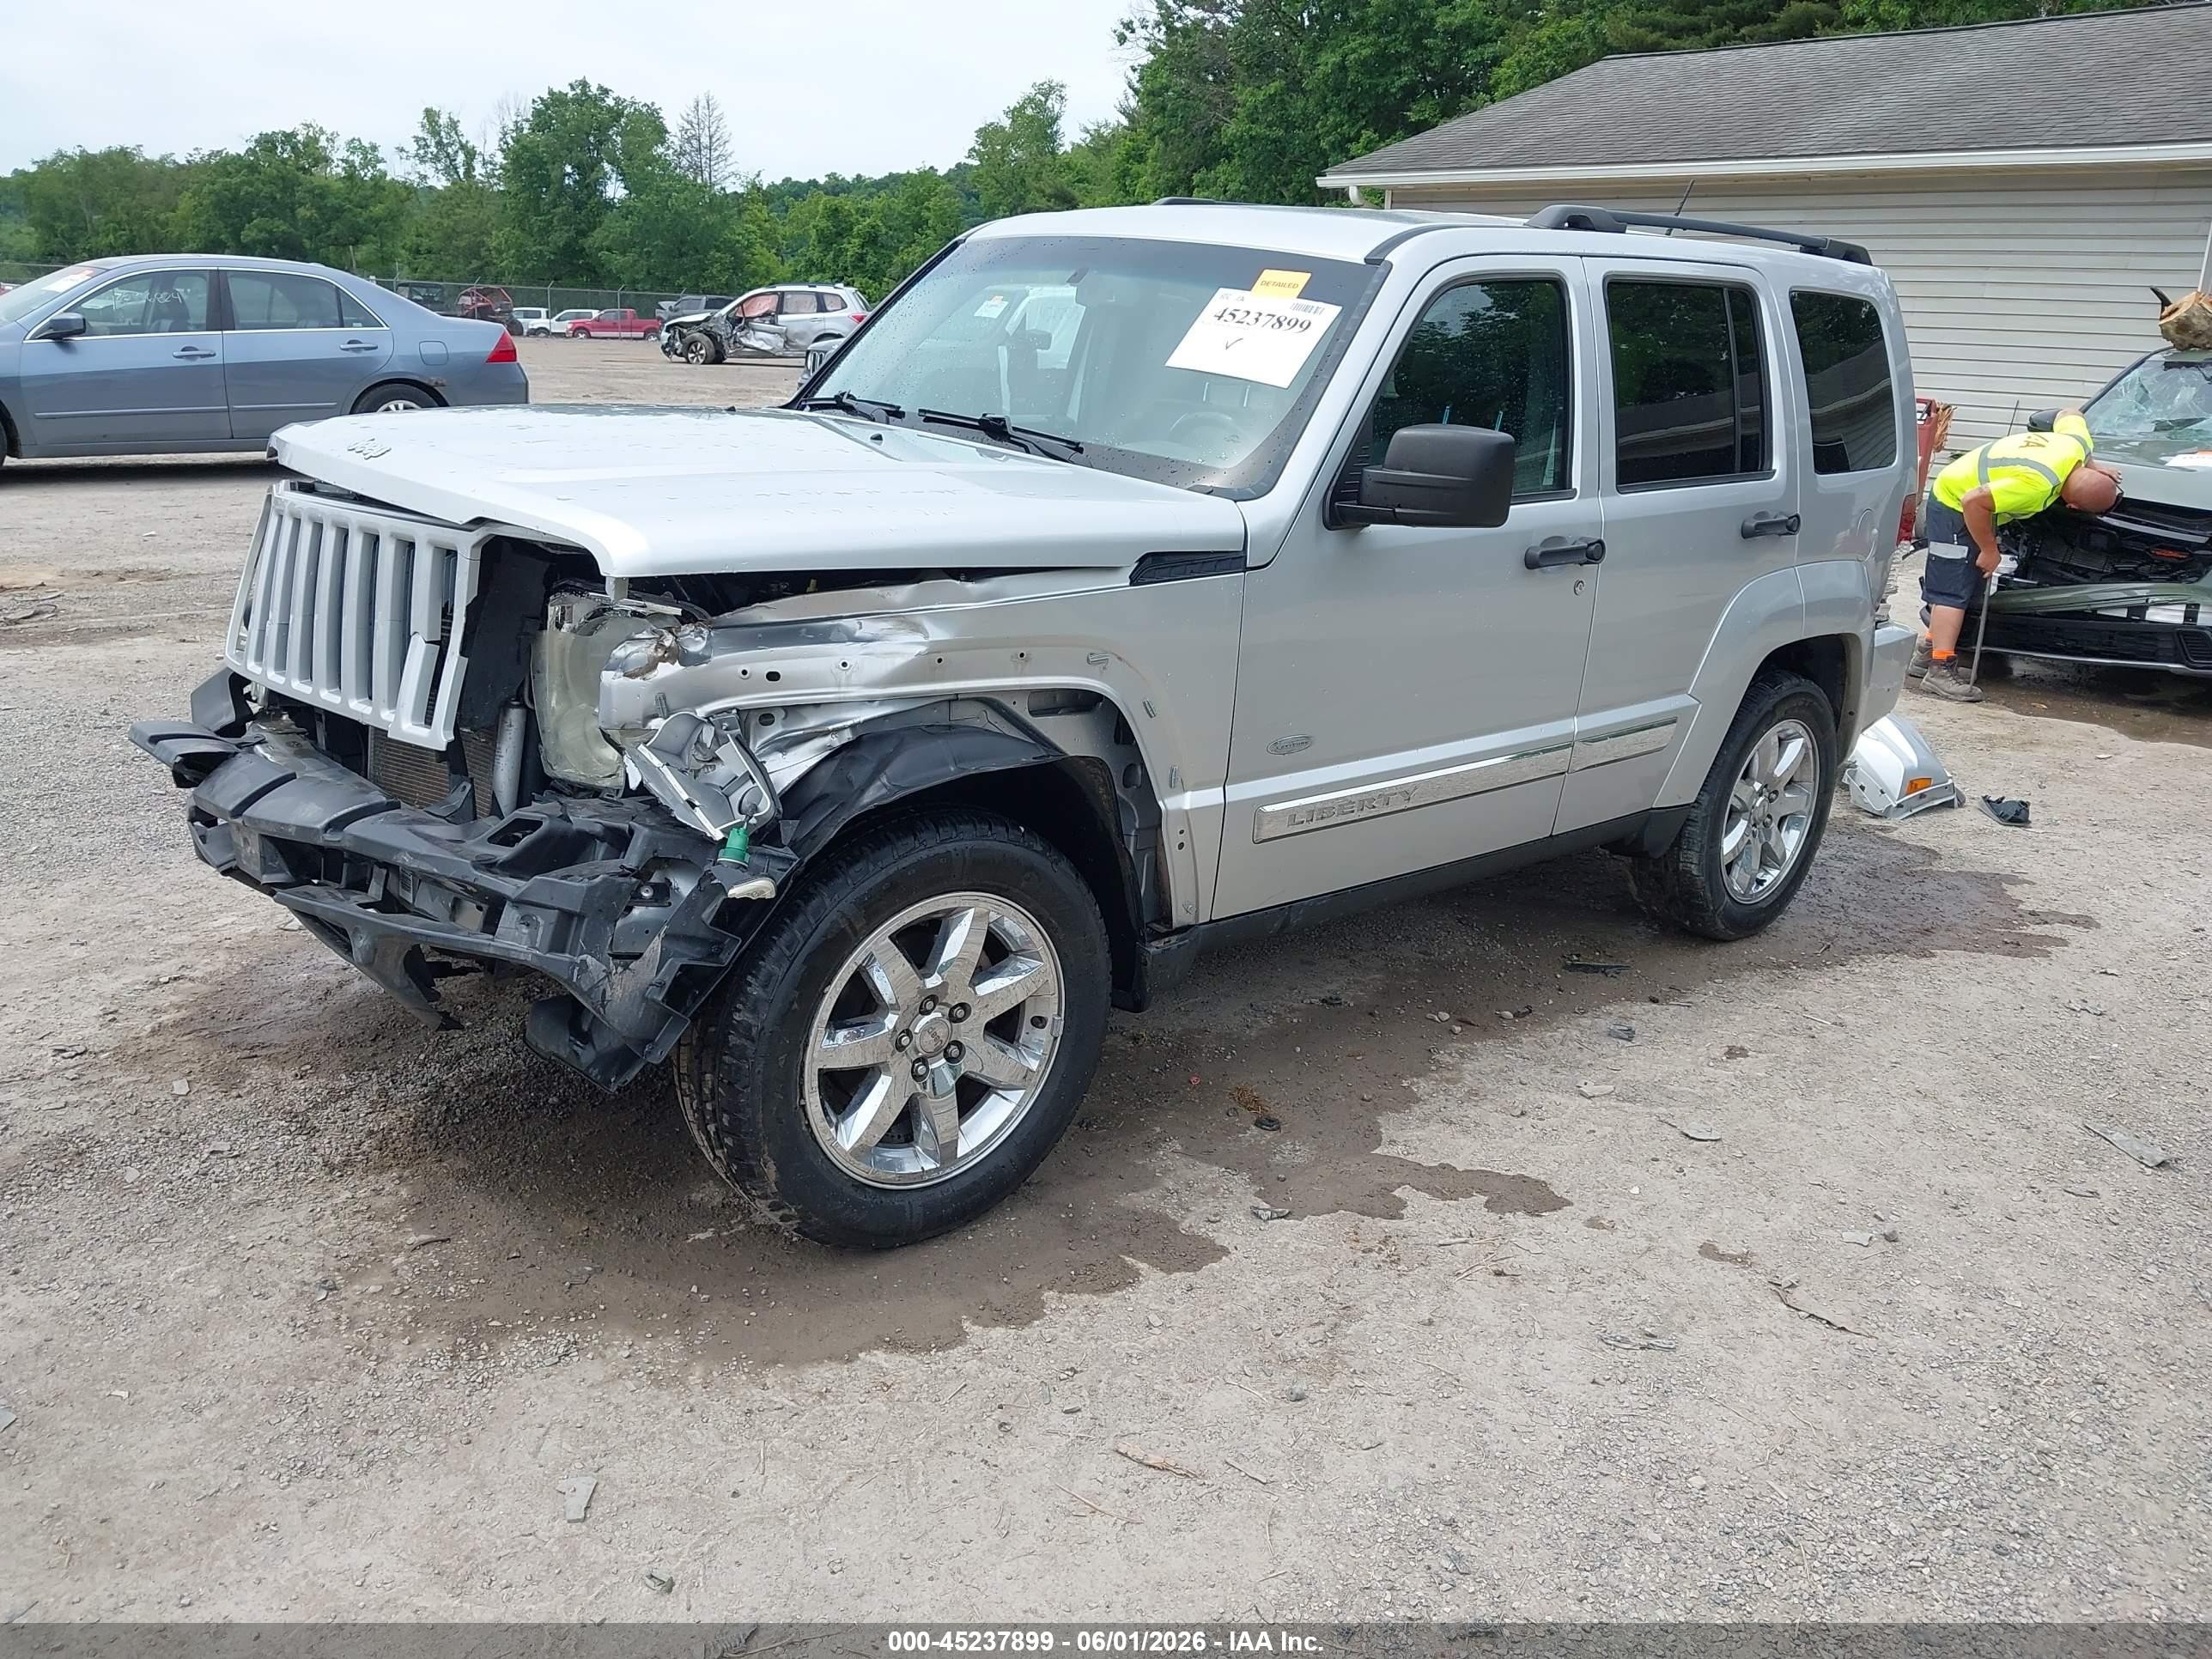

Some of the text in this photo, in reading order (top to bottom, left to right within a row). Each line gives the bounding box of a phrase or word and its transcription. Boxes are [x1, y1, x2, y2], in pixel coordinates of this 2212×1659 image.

[1260, 280, 1299, 289] DETAILED
[1213, 307, 1312, 333] 45237899
[1286, 785, 1419, 827] LIBERTY
